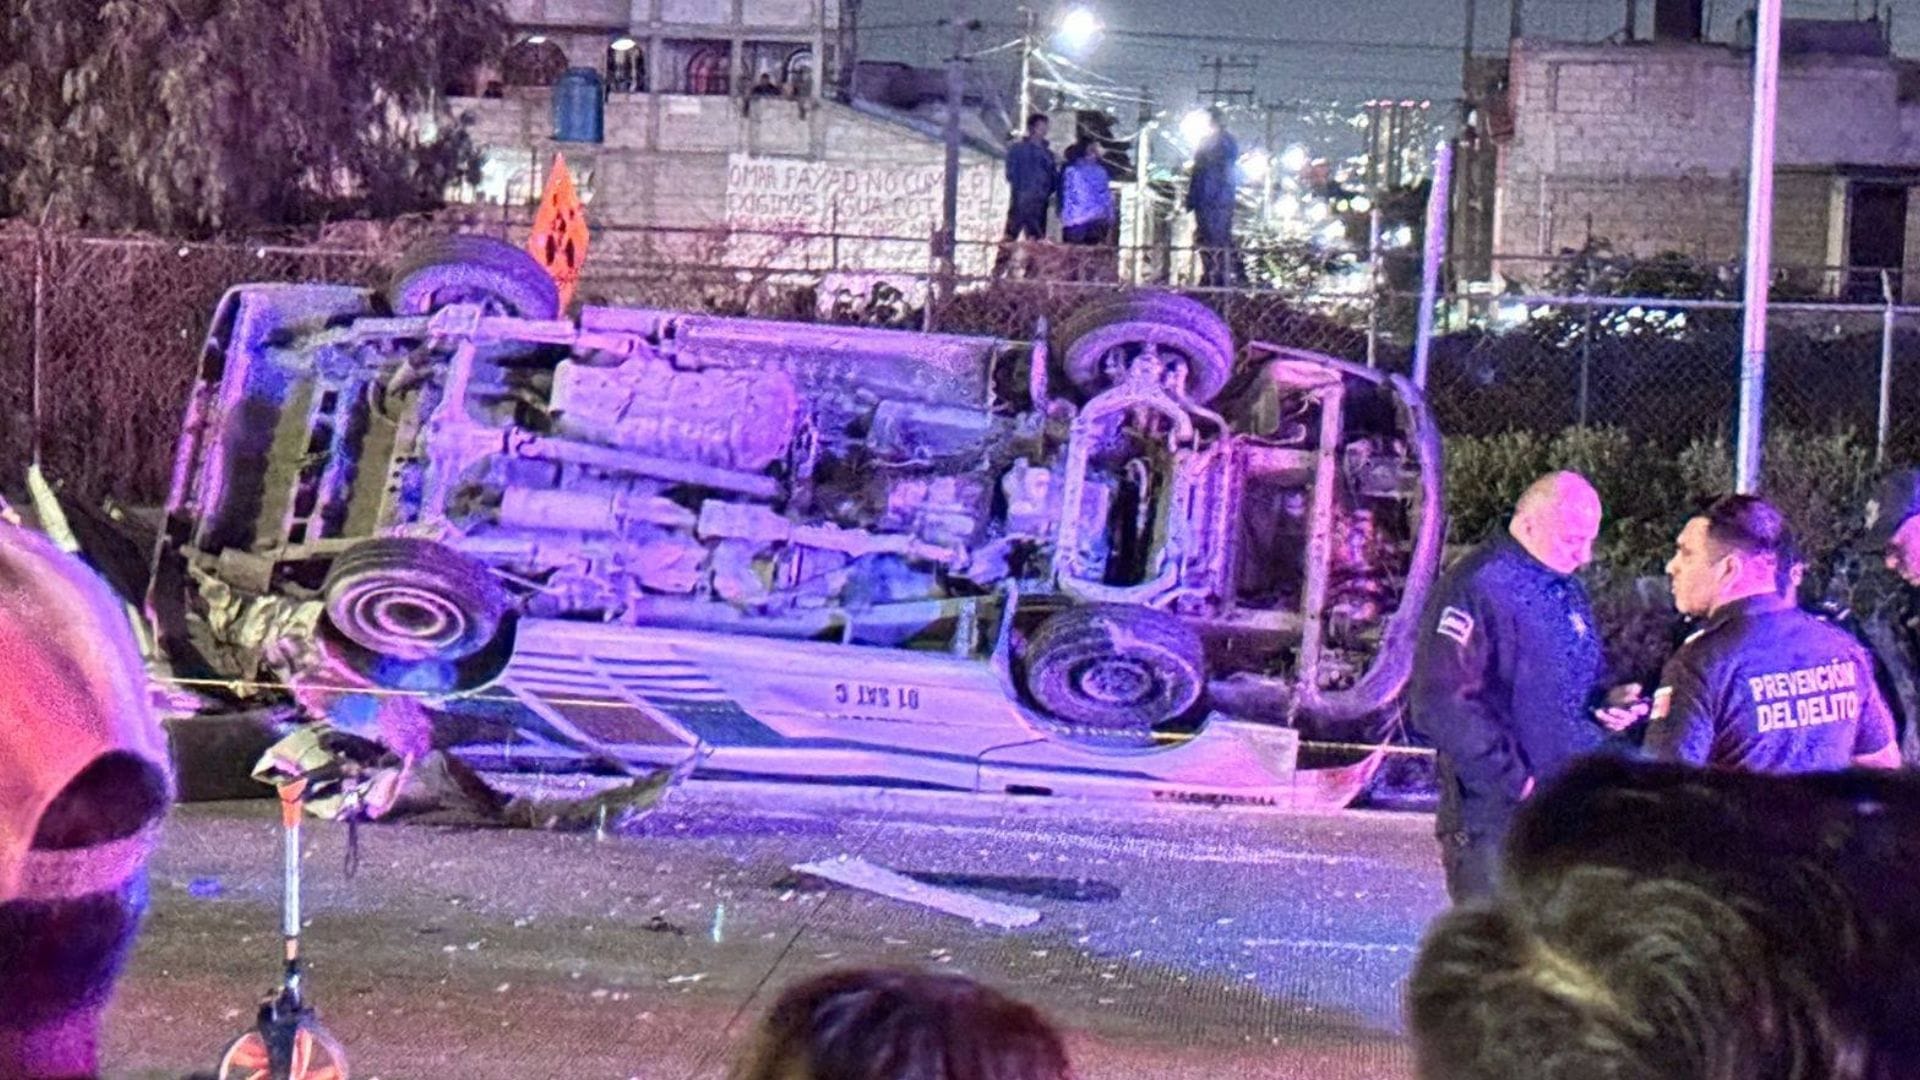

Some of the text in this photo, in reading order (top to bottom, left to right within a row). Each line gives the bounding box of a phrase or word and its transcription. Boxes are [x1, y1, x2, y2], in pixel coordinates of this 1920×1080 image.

[730, 165, 776, 189] OMAR
[866, 169, 897, 194] NO
[1749, 657, 1856, 702] PREVENCIÓN
[1757, 691, 1858, 733] DEL DELITO
